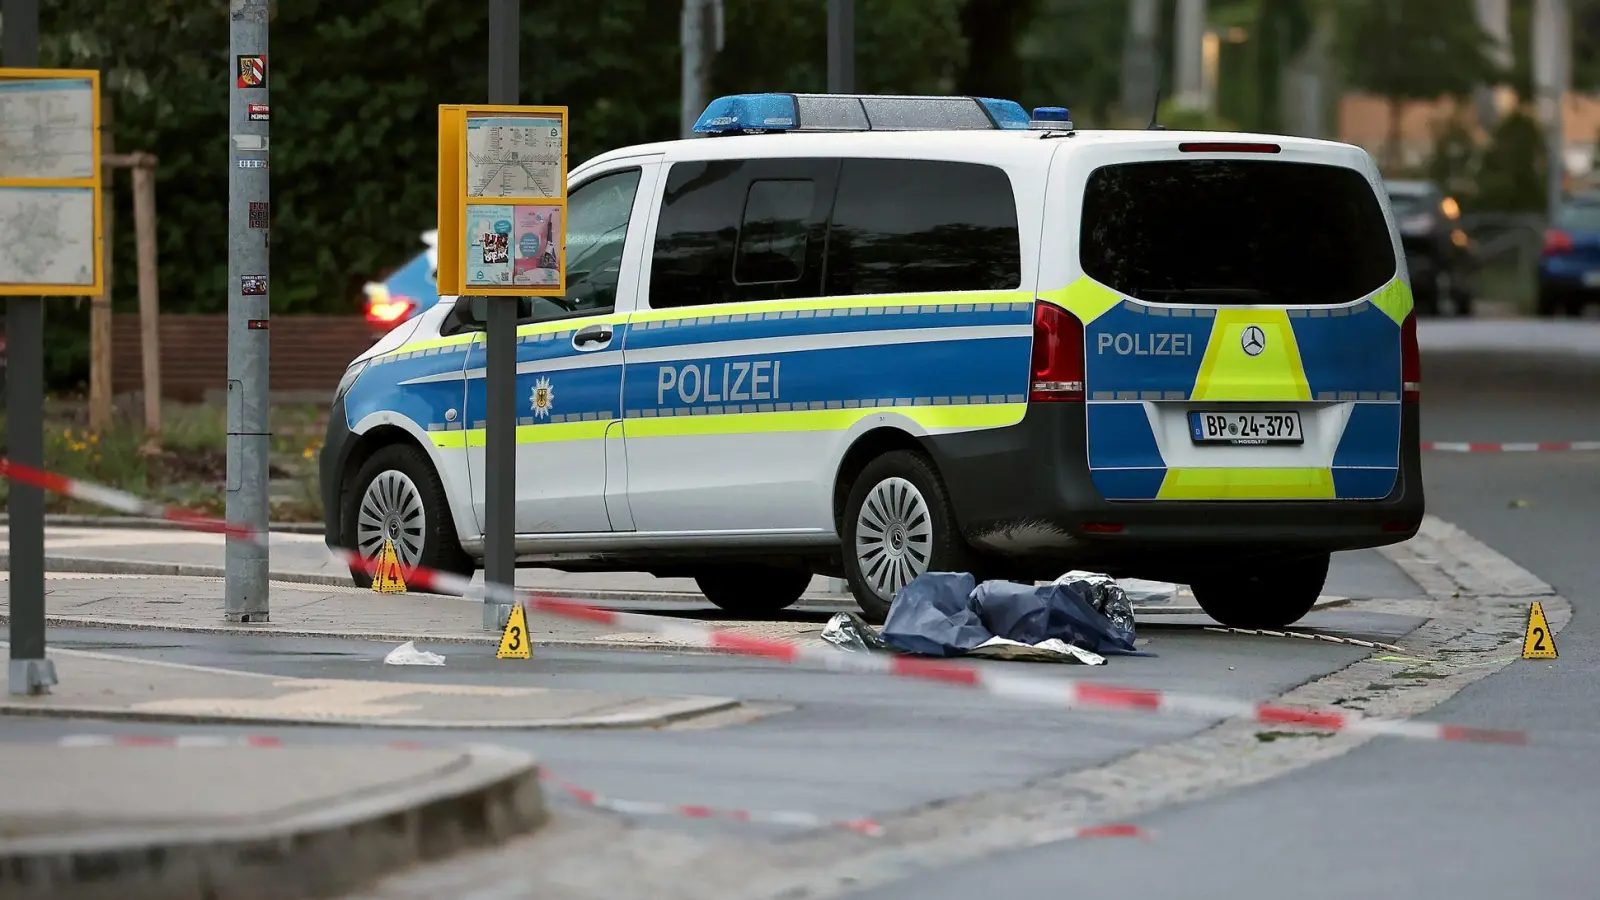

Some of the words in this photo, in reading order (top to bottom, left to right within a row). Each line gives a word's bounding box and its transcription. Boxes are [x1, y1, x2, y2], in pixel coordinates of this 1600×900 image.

[1097, 332, 1192, 355] POLIZEI
[657, 360, 780, 405] POLIZEI
[1206, 415, 1227, 437] BP
[1238, 415, 1294, 437] 24-379
[387, 562, 398, 585] 4
[508, 626, 521, 651] 3
[1532, 626, 1546, 651] 2
